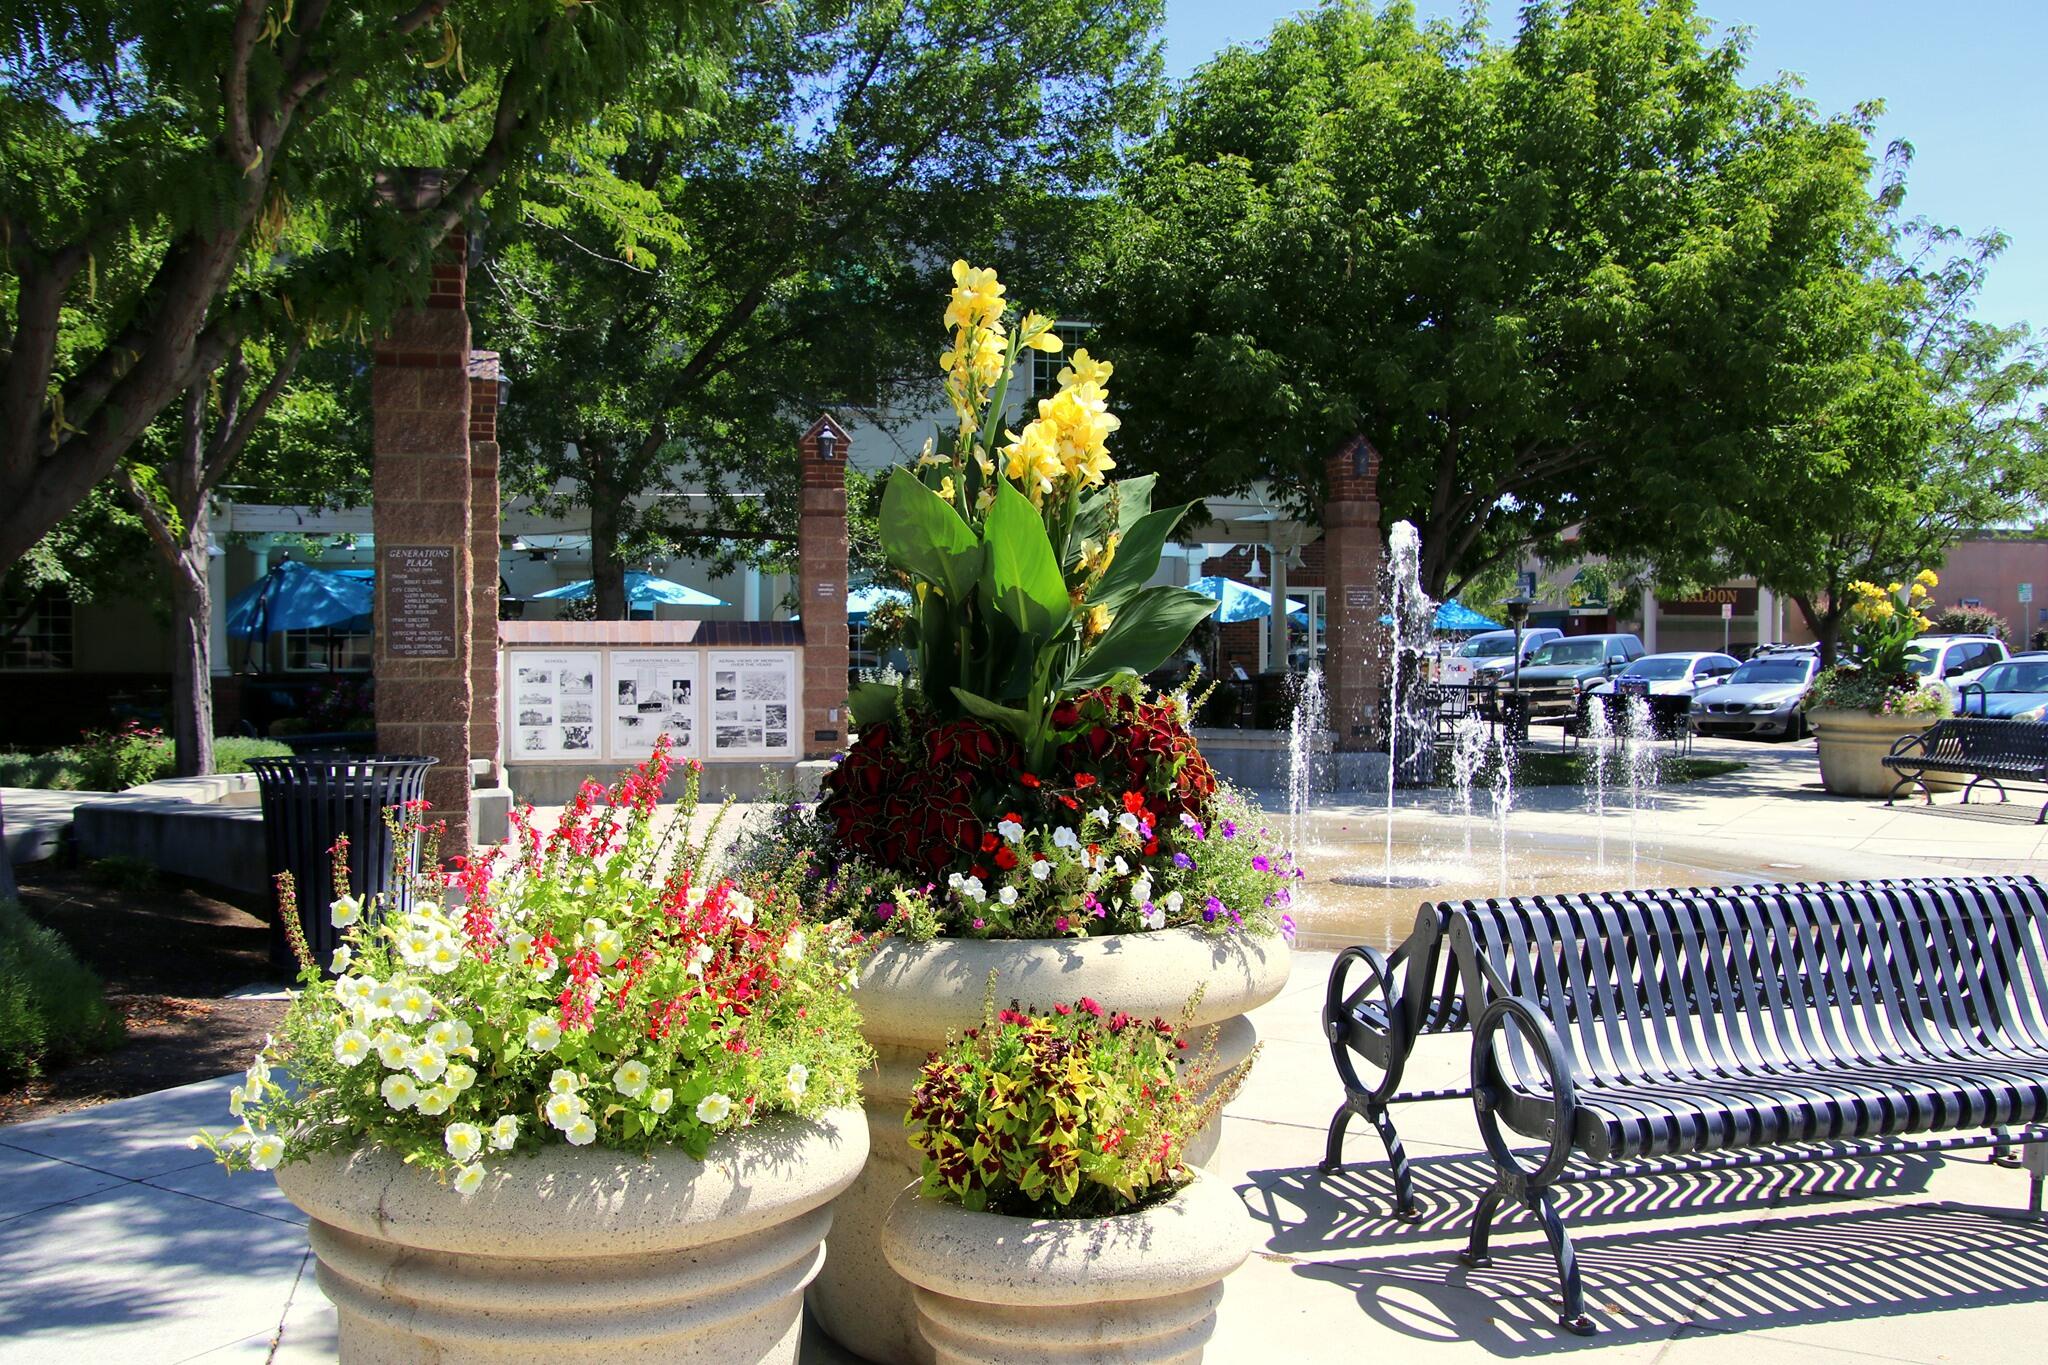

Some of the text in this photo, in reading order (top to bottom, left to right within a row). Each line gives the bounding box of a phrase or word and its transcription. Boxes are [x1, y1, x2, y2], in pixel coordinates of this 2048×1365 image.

[389, 549, 450, 558] GENERATIONS
[406, 559, 433, 567] PLAZA
[1680, 590, 1738, 603] SALOON
